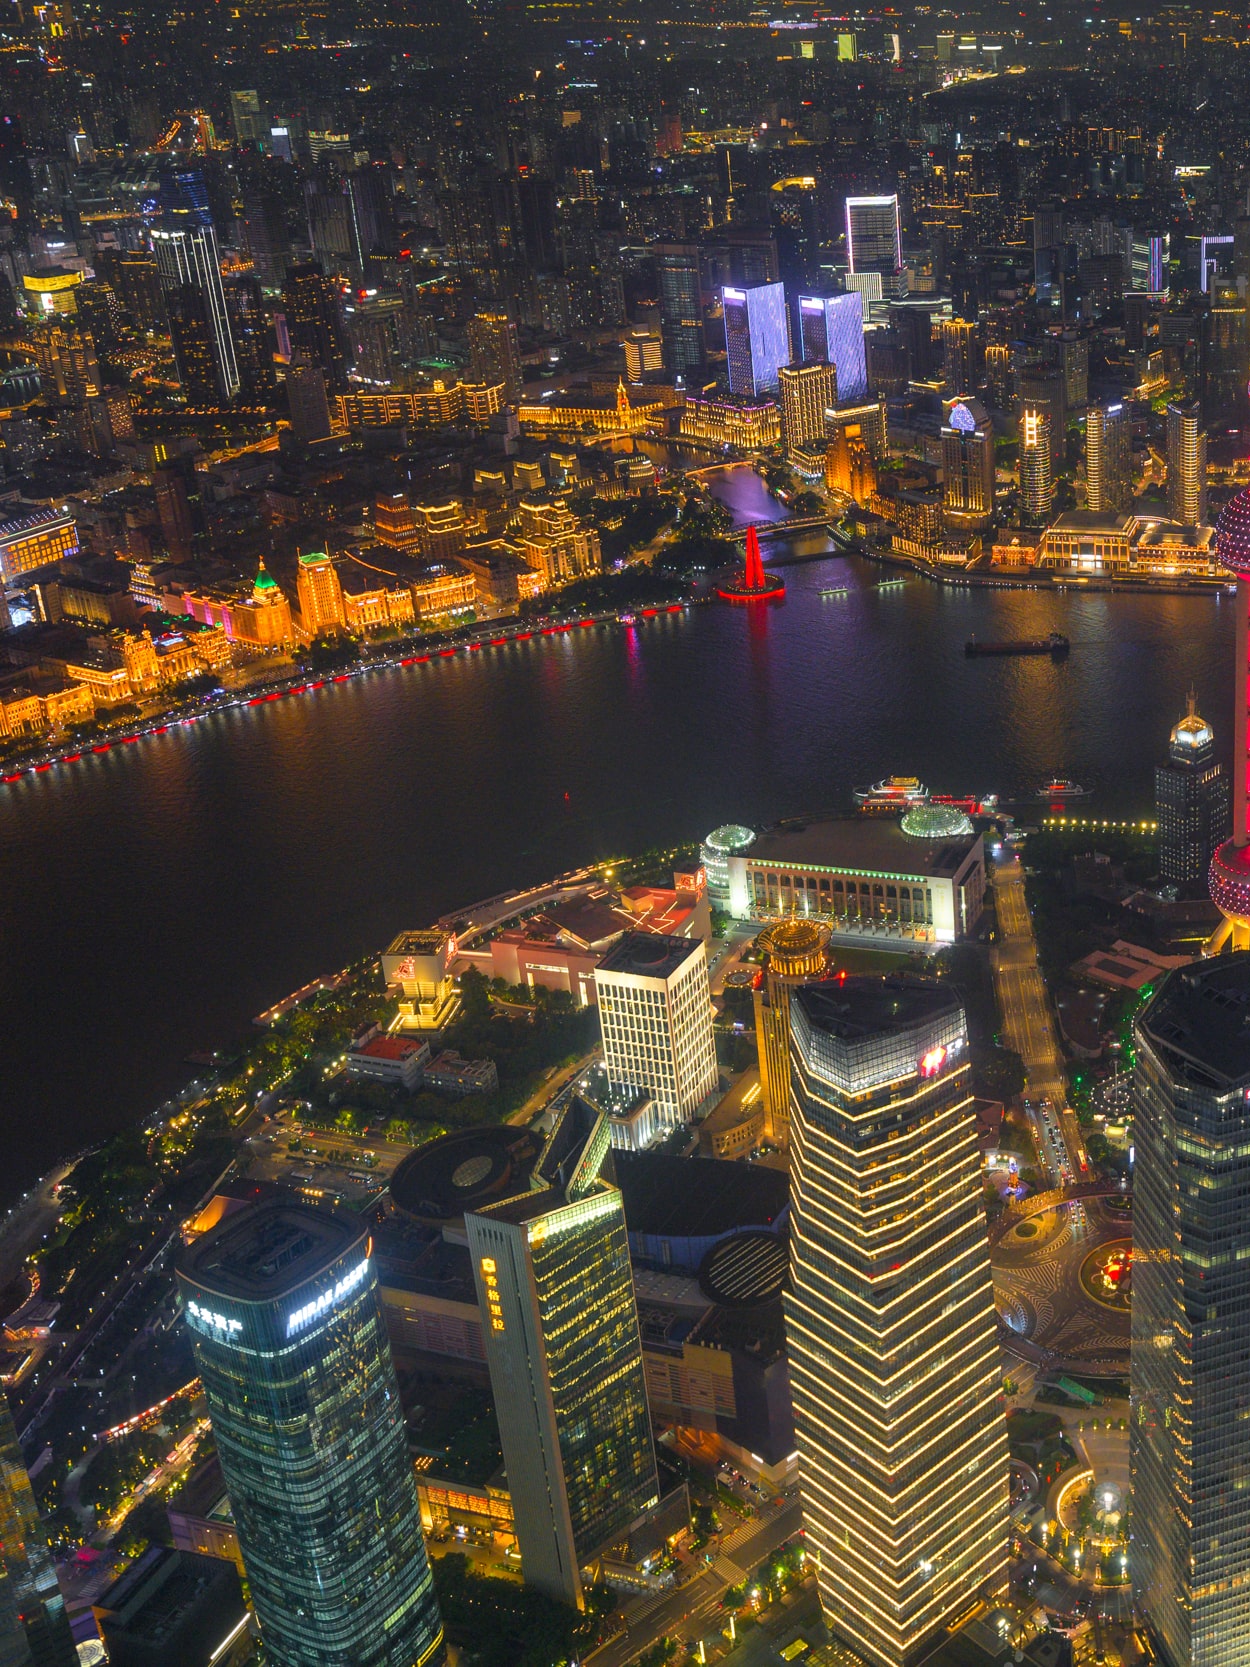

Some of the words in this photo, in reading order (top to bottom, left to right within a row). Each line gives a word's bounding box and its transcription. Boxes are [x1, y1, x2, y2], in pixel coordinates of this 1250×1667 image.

[289, 1289, 333, 1328] MIRAE
[335, 1258, 369, 1298] ASSET
[485, 1275, 505, 1331] 香格里拉
